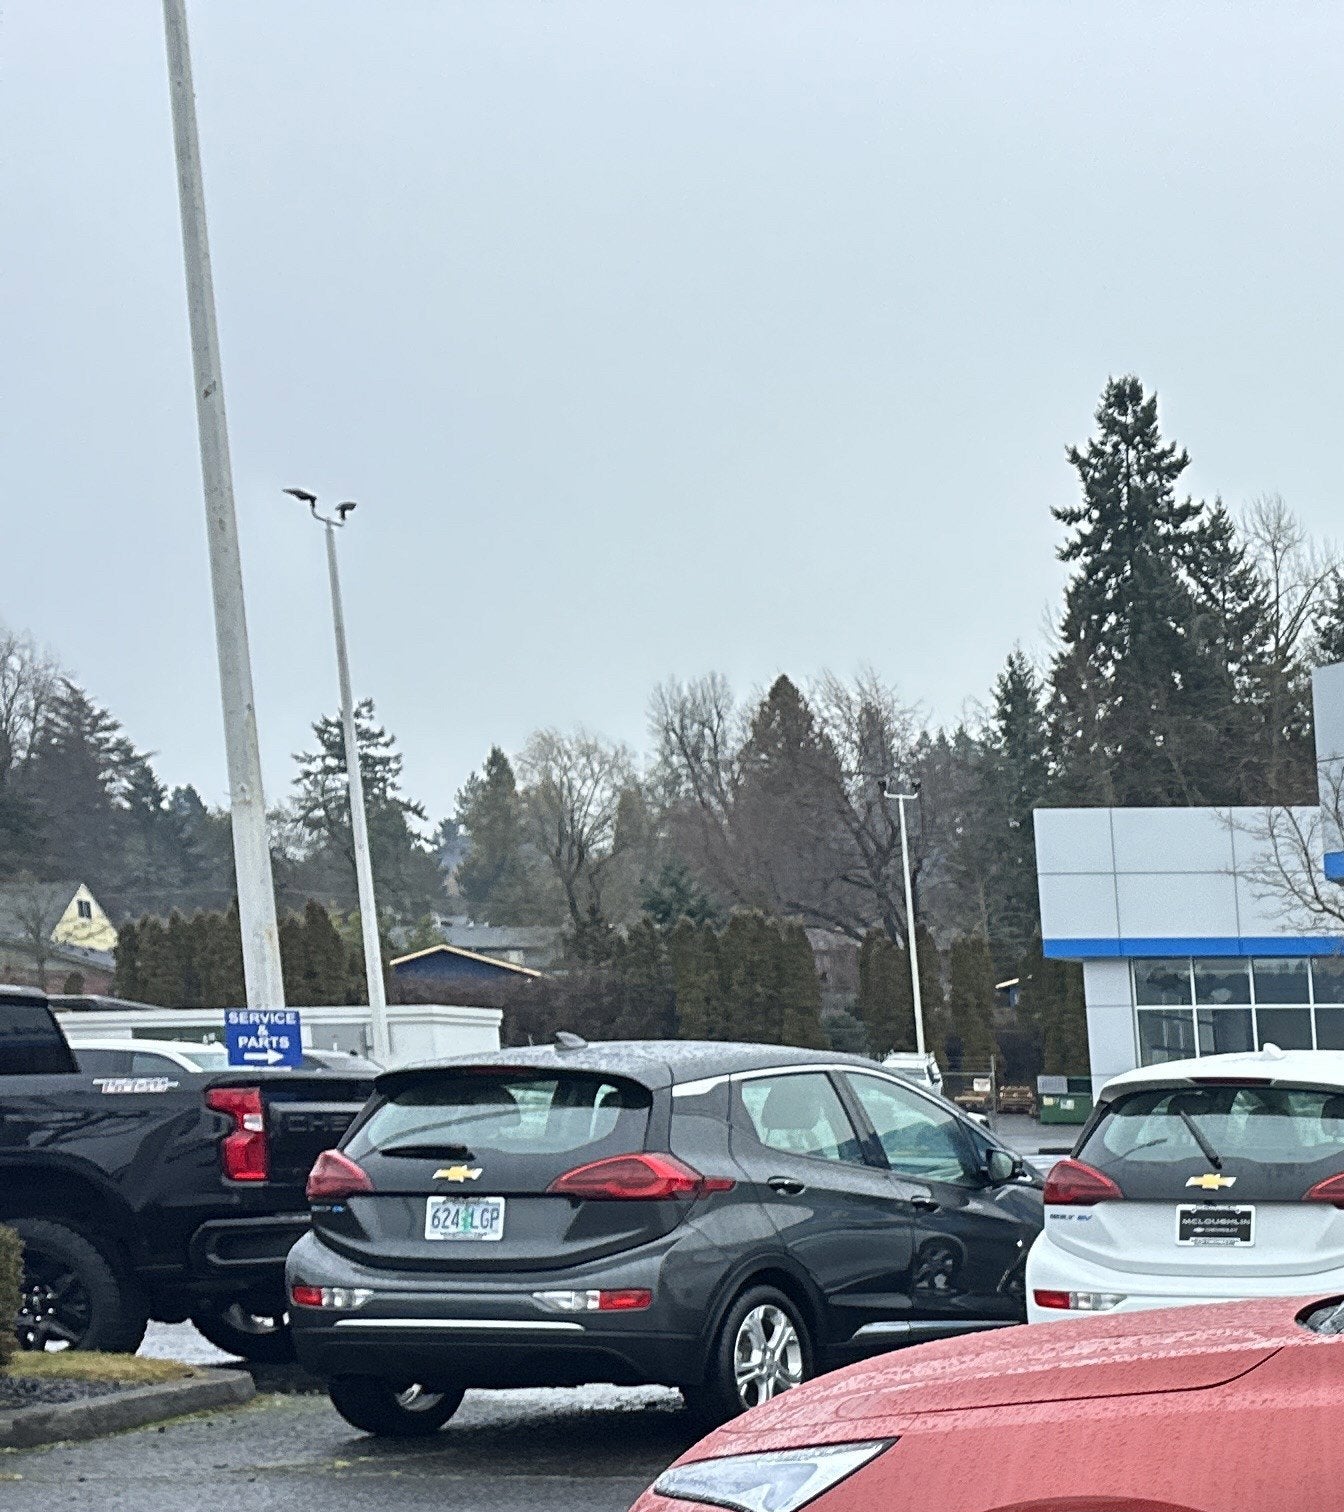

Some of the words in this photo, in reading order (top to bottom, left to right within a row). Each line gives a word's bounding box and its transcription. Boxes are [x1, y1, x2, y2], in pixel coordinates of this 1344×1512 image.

[228, 1011, 297, 1025] SERVICE
[257, 1024, 269, 1036] &
[237, 1035, 290, 1049] PARTS
[431, 1207, 460, 1229] 624
[470, 1206, 500, 1229] LGP
